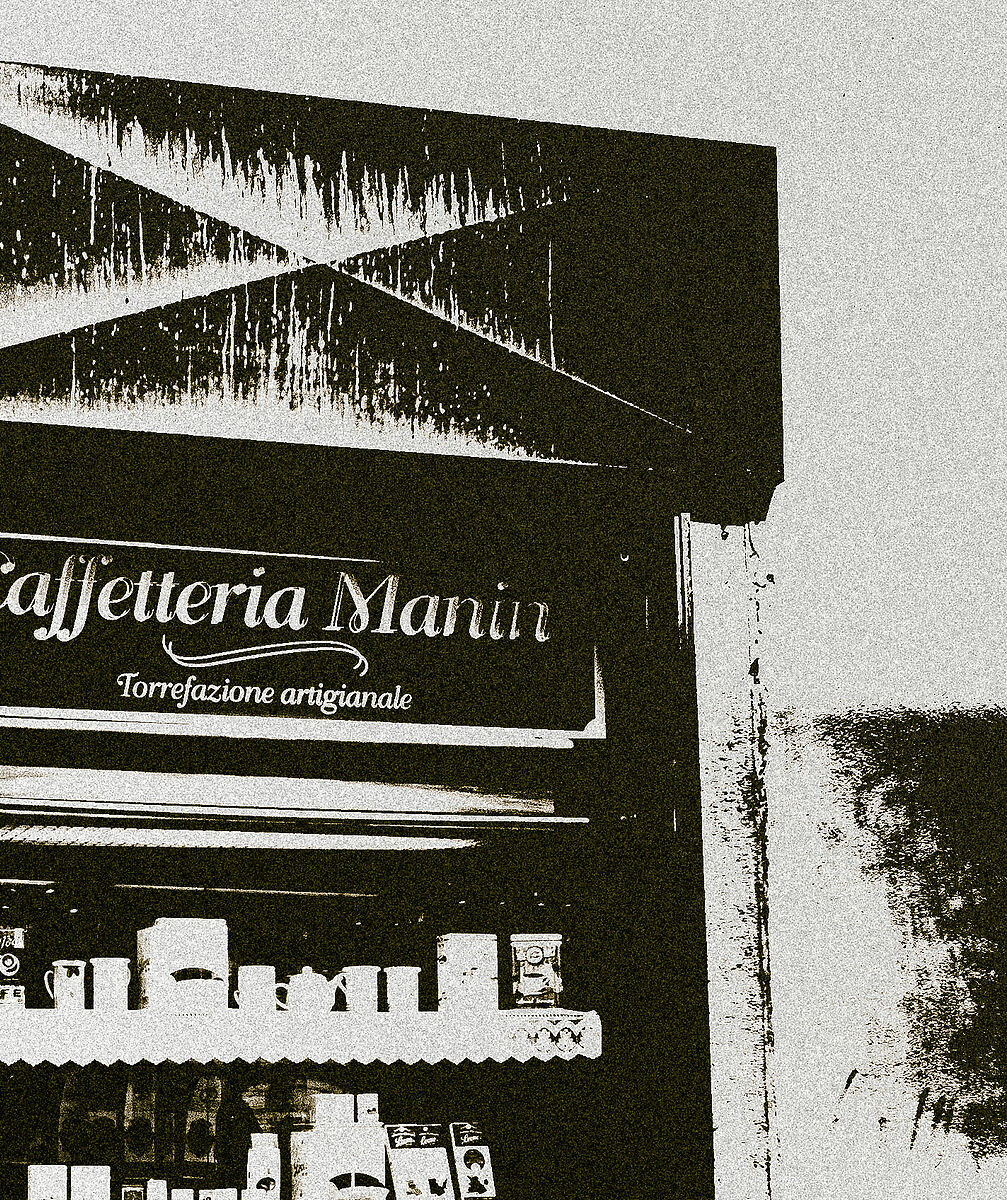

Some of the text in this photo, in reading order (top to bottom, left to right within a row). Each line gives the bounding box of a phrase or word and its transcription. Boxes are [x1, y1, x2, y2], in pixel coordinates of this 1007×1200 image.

[322, 570, 550, 643] Manin
[116, 671, 413, 716] Torrefazione artigianale
